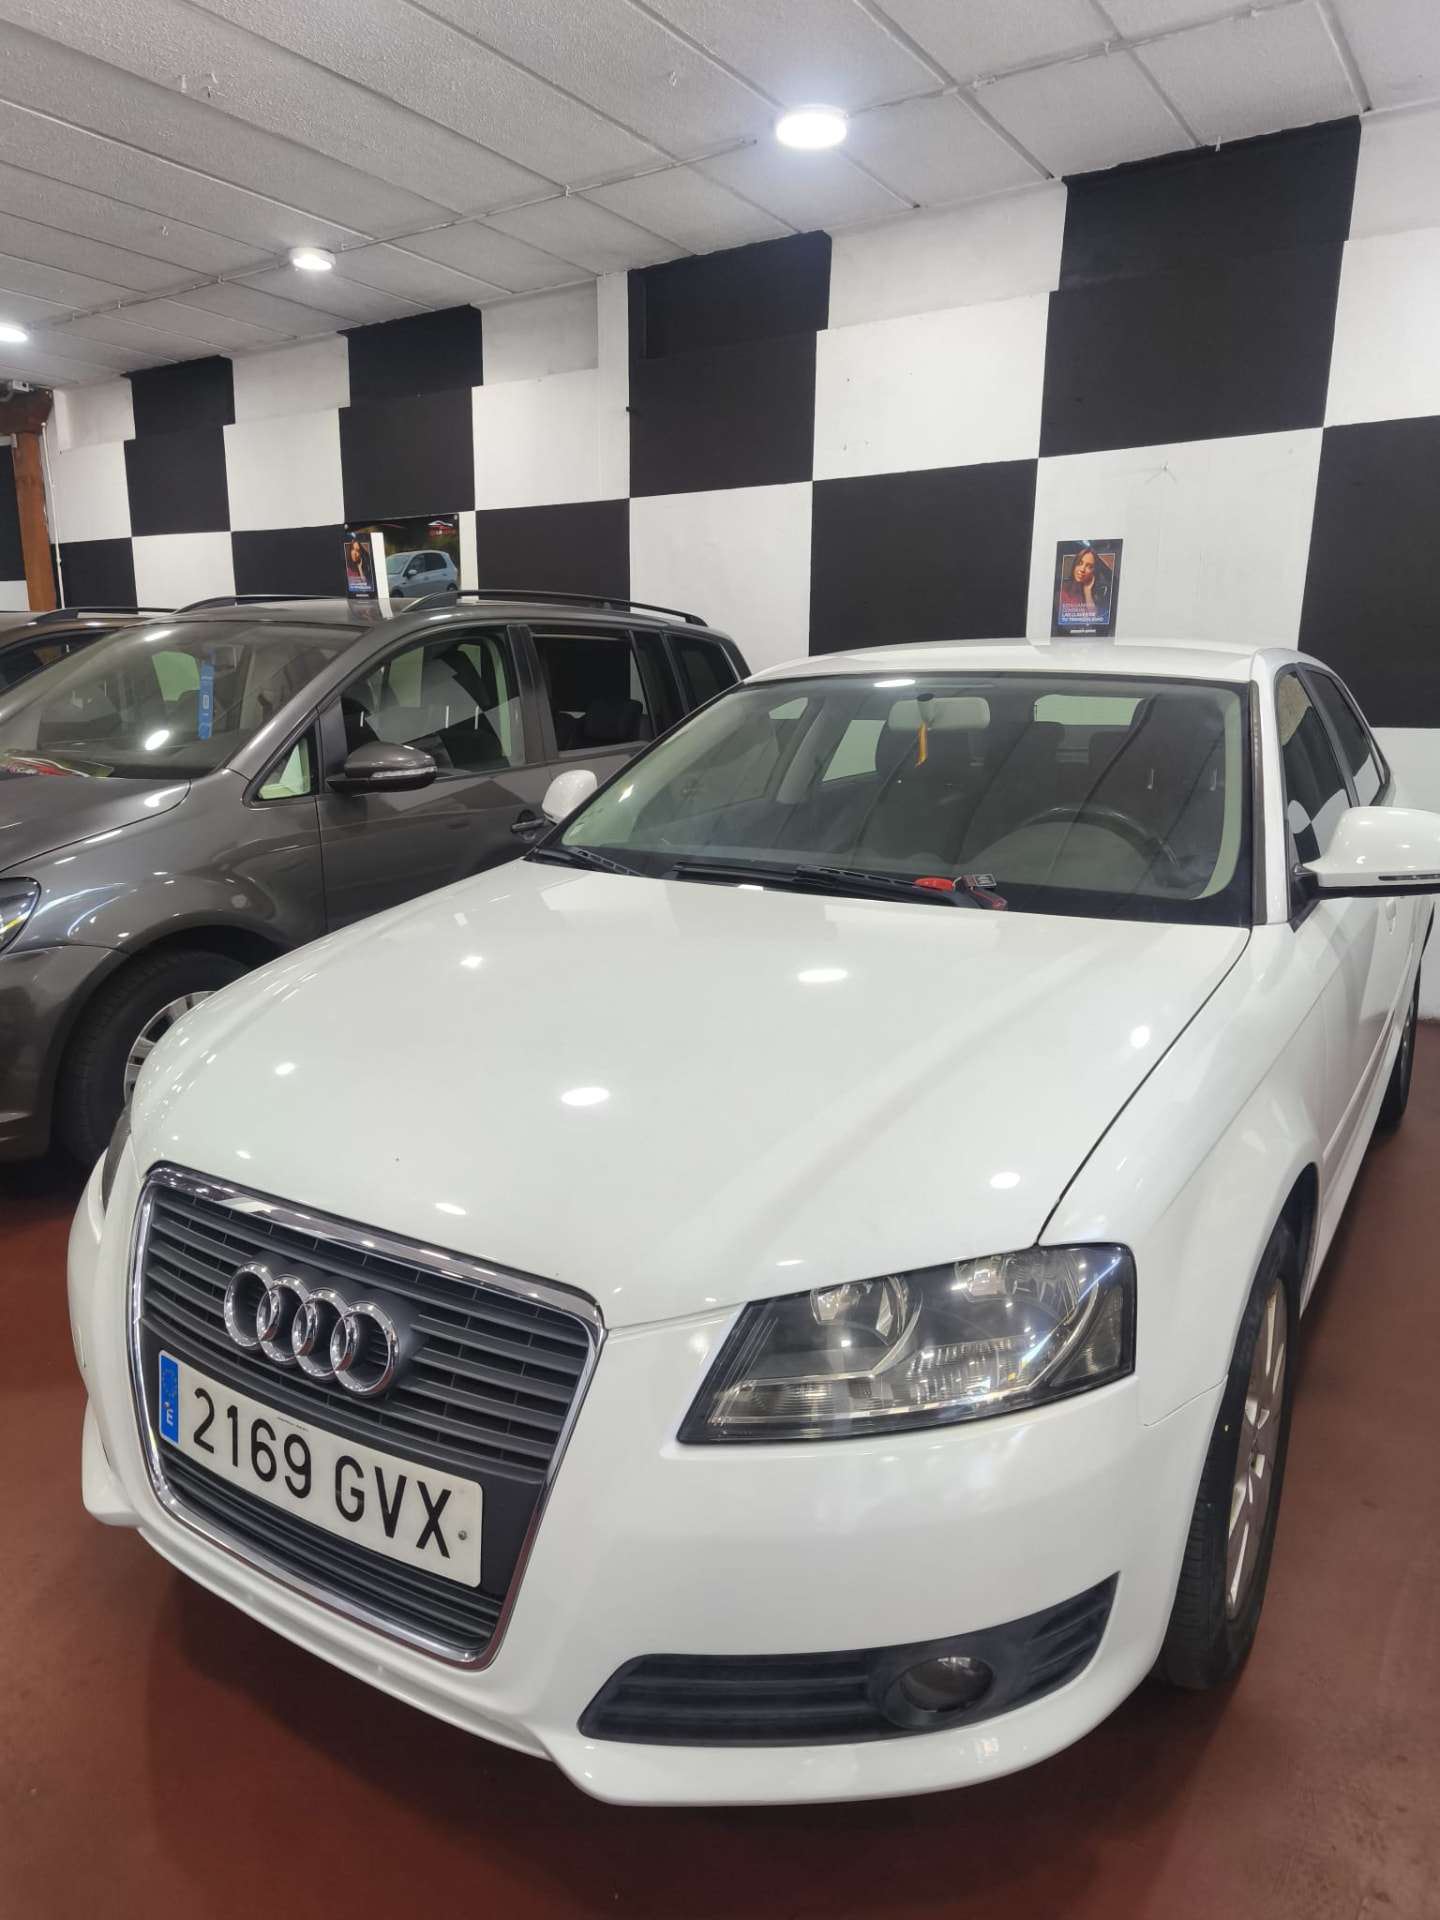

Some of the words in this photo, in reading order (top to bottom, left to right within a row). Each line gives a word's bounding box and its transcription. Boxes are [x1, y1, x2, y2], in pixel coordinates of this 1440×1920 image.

[164, 1407, 174, 1427] E
[193, 1387, 312, 1499] 2169
[335, 1454, 452, 1559] GVX
